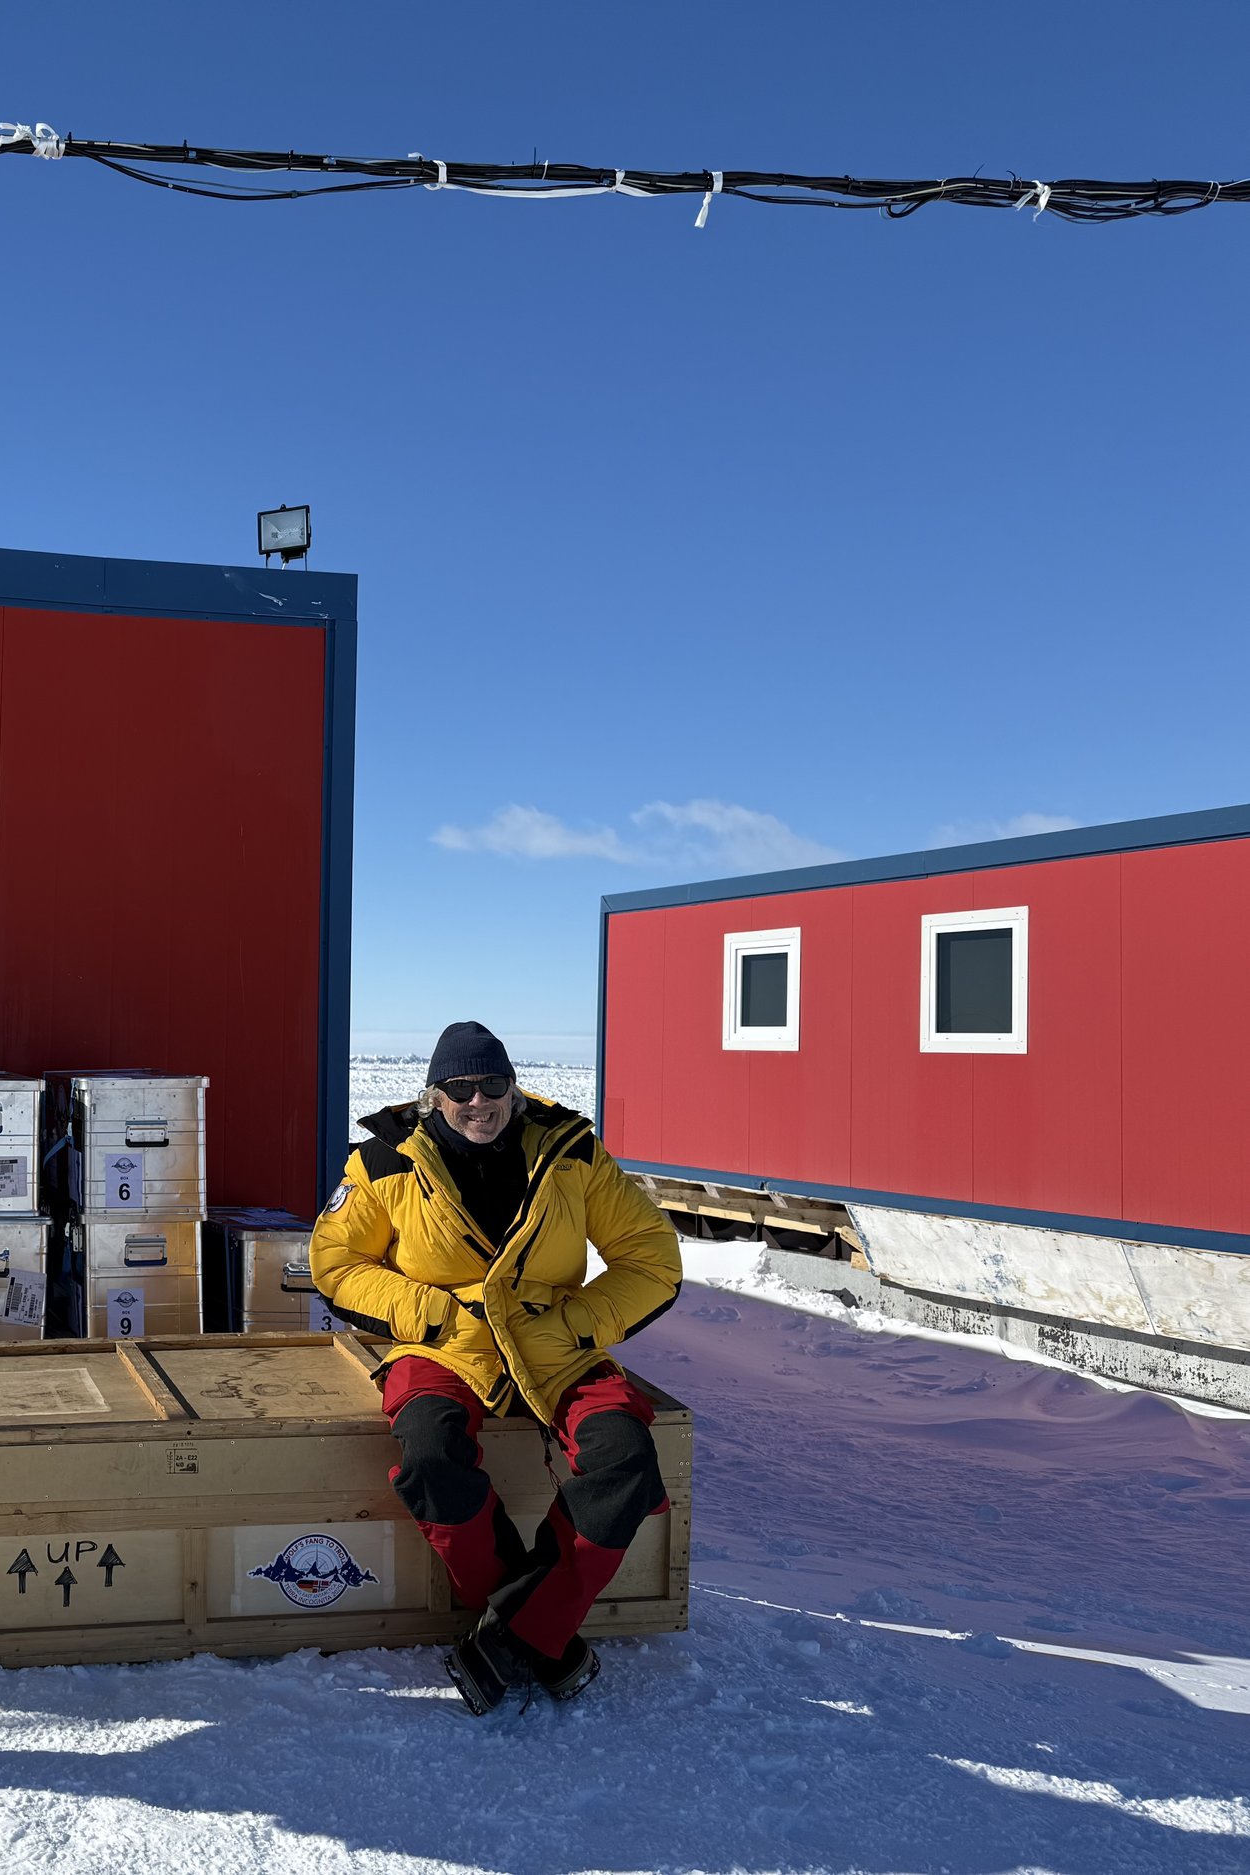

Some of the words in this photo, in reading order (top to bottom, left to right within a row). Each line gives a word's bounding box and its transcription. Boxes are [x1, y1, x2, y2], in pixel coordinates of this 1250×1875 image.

[119, 1183, 130, 1200] 6
[120, 1317, 131, 1335] 9
[321, 1316, 332, 1331] 3
[305, 1537, 324, 1545] FANG
[325, 1539, 335, 1549] TO
[47, 1540, 98, 1564] UP
[284, 1583, 299, 1600] TERRA
[298, 1595, 332, 1605] INCOGNITA
